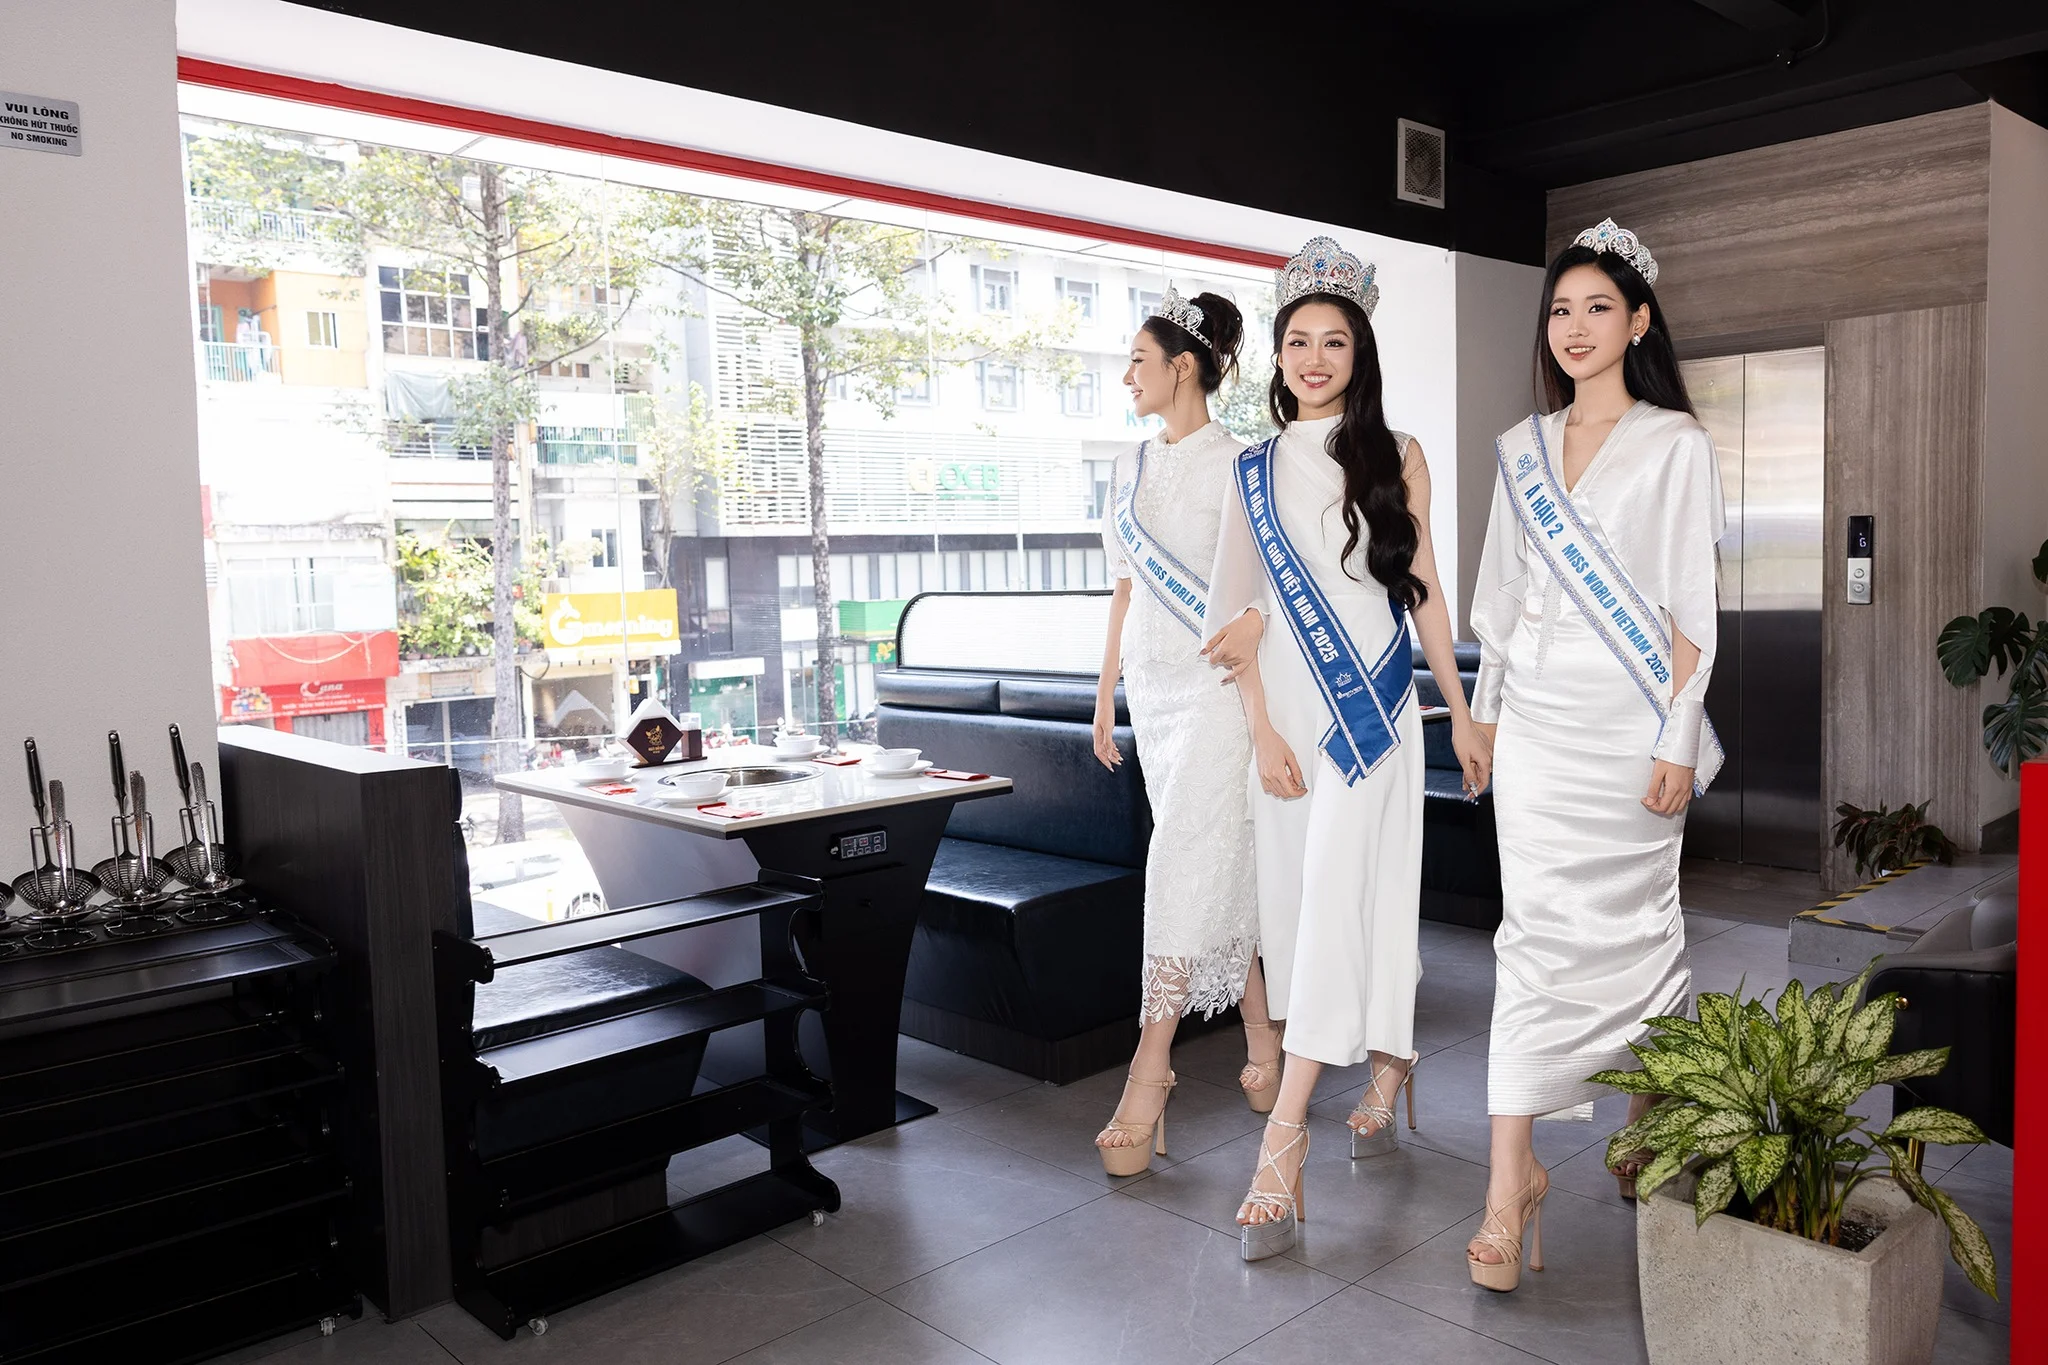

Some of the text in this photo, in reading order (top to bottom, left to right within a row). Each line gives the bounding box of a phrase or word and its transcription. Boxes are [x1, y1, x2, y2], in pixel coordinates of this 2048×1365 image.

[5, 103, 69, 120] VUI LÒNG
[11, 131, 68, 147] NO SMOKING
[31, 119, 47, 130] HÚT
[50, 122, 78, 134] THUỐC
[940, 463, 1000, 491] OCB
[1246, 465, 1260, 494] HOA
[1524, 482, 1543, 500] Á
[1250, 490, 1265, 519] HẬU
[1530, 495, 1558, 528] HẬU
[1256, 516, 1276, 544] THẾ
[1546, 522, 1564, 540] 2
[1266, 541, 1286, 570] GIỚI
[1561, 542, 1590, 574] MISS
[1134, 541, 1142, 553] 1
[1145, 556, 1167, 581] MISS
[1165, 575, 1196, 607] WORLD
[1280, 567, 1302, 596] VIỆT
[1582, 570, 1617, 610] WORLD
[1292, 594, 1320, 629] NAM
[1309, 626, 1340, 664] 2025
[1610, 606, 1653, 655] VIETNAM
[1645, 652, 1670, 685] 2025
